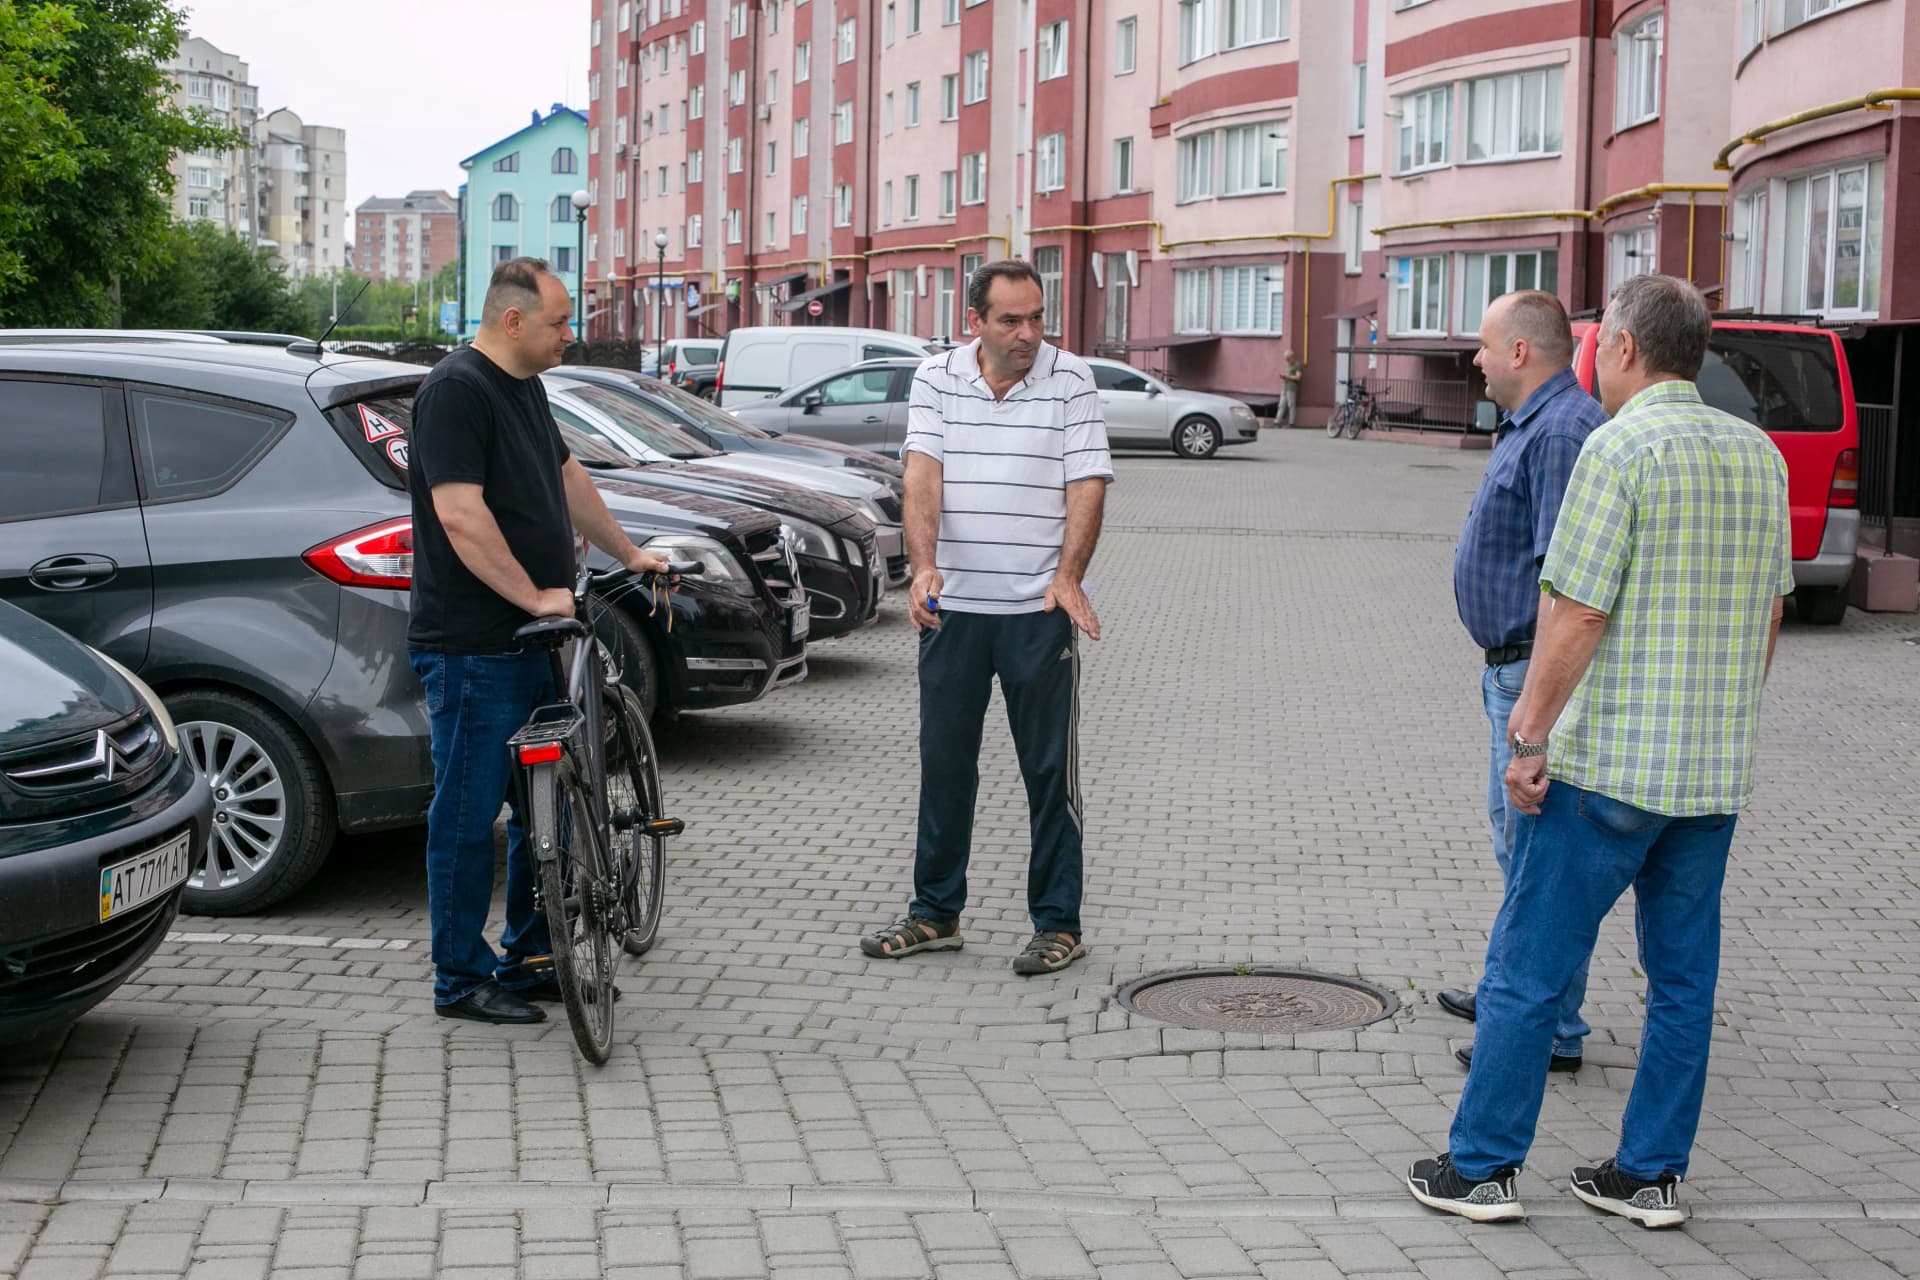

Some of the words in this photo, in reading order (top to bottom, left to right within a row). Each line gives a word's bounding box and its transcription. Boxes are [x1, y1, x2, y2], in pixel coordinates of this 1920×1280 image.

[112, 867, 136, 910] AT
[139, 851, 169, 898] 7711
[170, 842, 188, 881] AT
